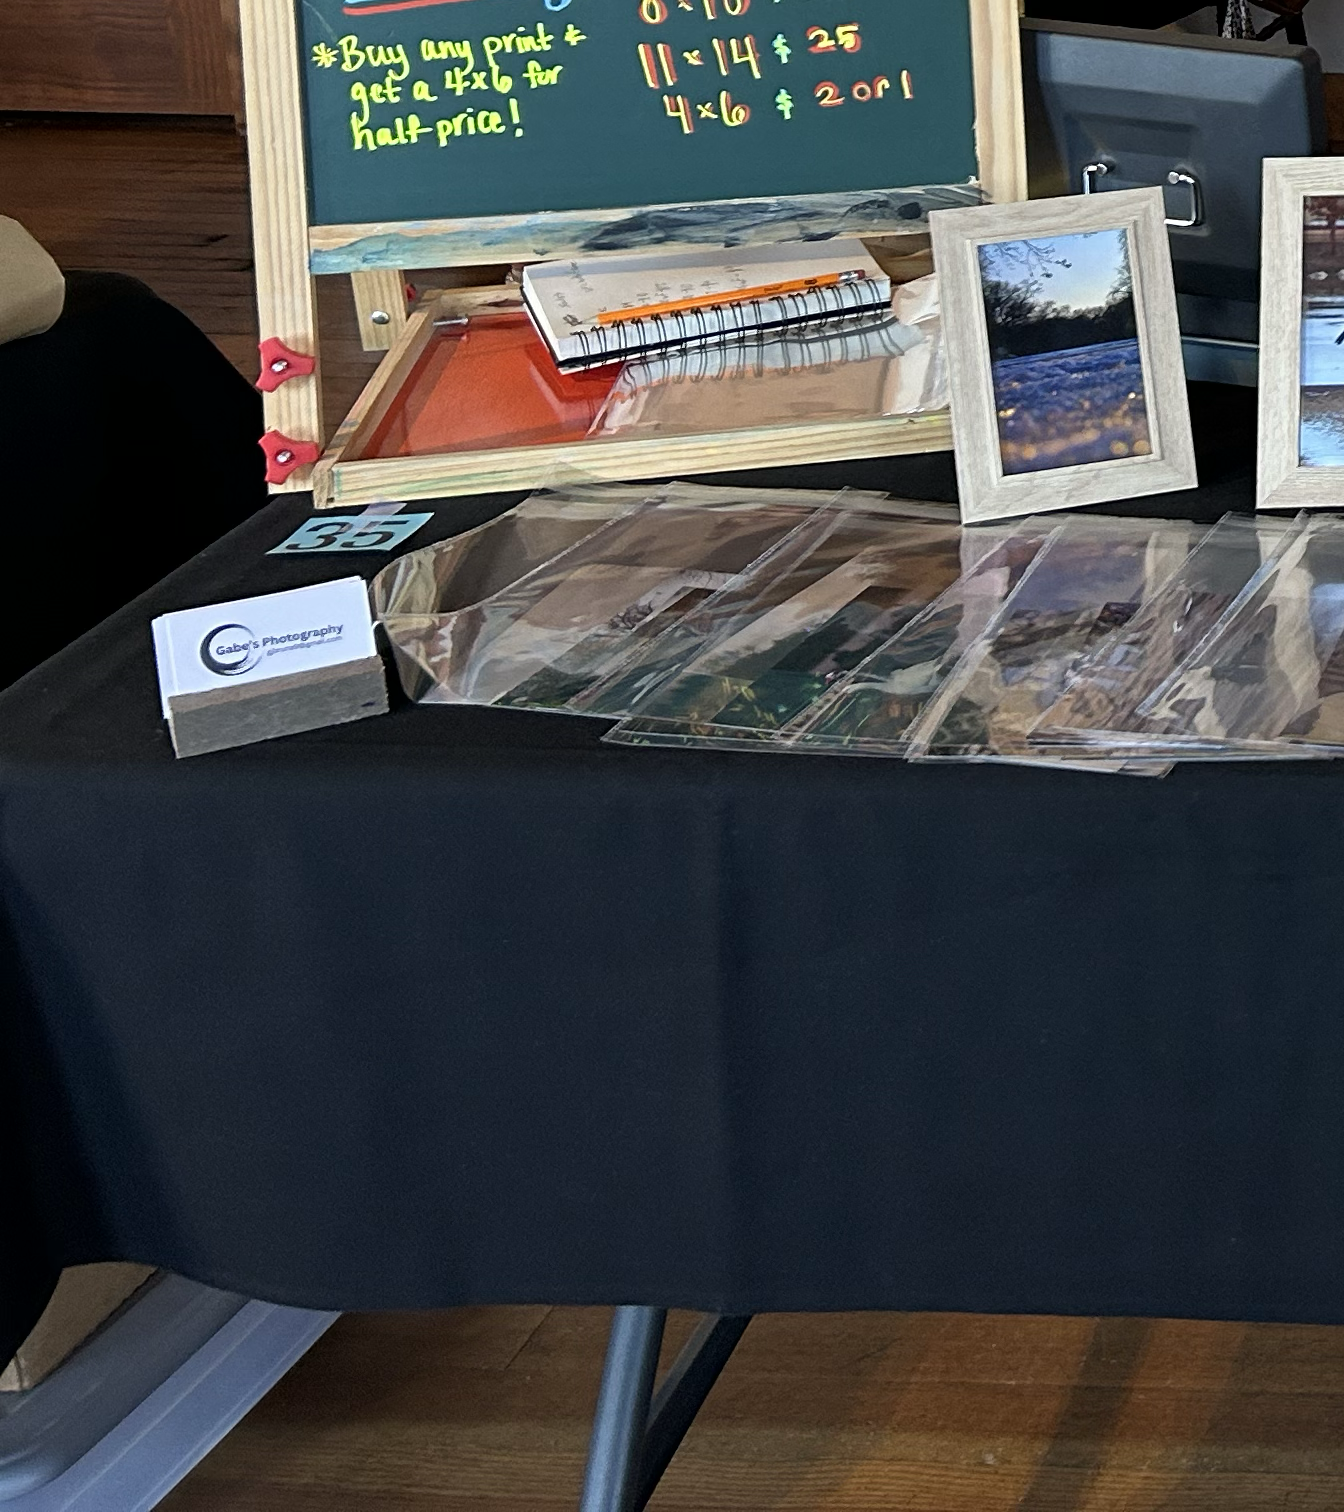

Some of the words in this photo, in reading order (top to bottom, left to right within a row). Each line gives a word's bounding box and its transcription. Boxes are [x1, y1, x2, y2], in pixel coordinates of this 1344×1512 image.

[420, 38, 476, 76] any
[350, 76, 402, 128] get
[412, 80, 438, 102] a
[444, 66, 513, 95] 4x6
[522, 60, 564, 89] for
[285, 520, 410, 551] 35
[216, 639, 259, 656] Gabe's
[262, 624, 344, 647] Photography
